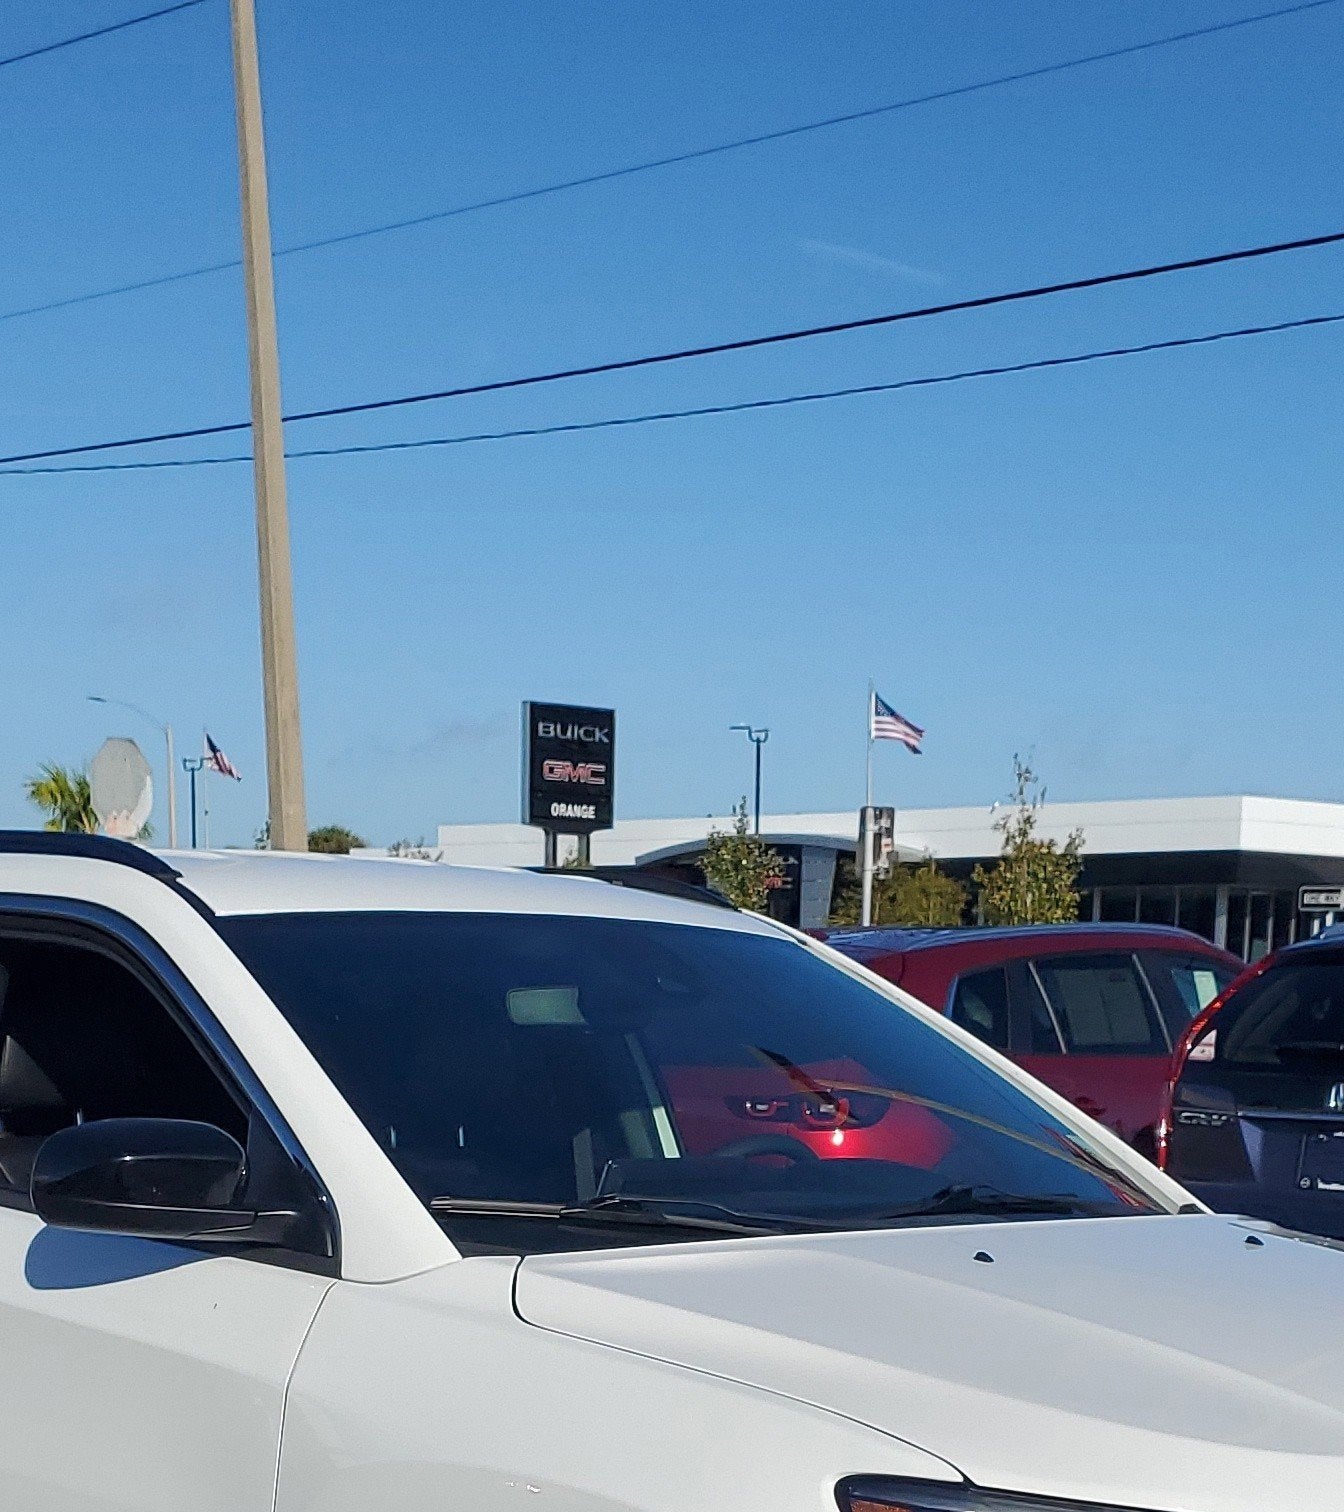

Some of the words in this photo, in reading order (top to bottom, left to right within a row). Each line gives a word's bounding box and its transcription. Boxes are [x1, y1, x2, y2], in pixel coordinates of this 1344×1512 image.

[537, 721, 610, 743] BUICK
[542, 759, 607, 785] GMC
[550, 802, 597, 819] ORANGE
